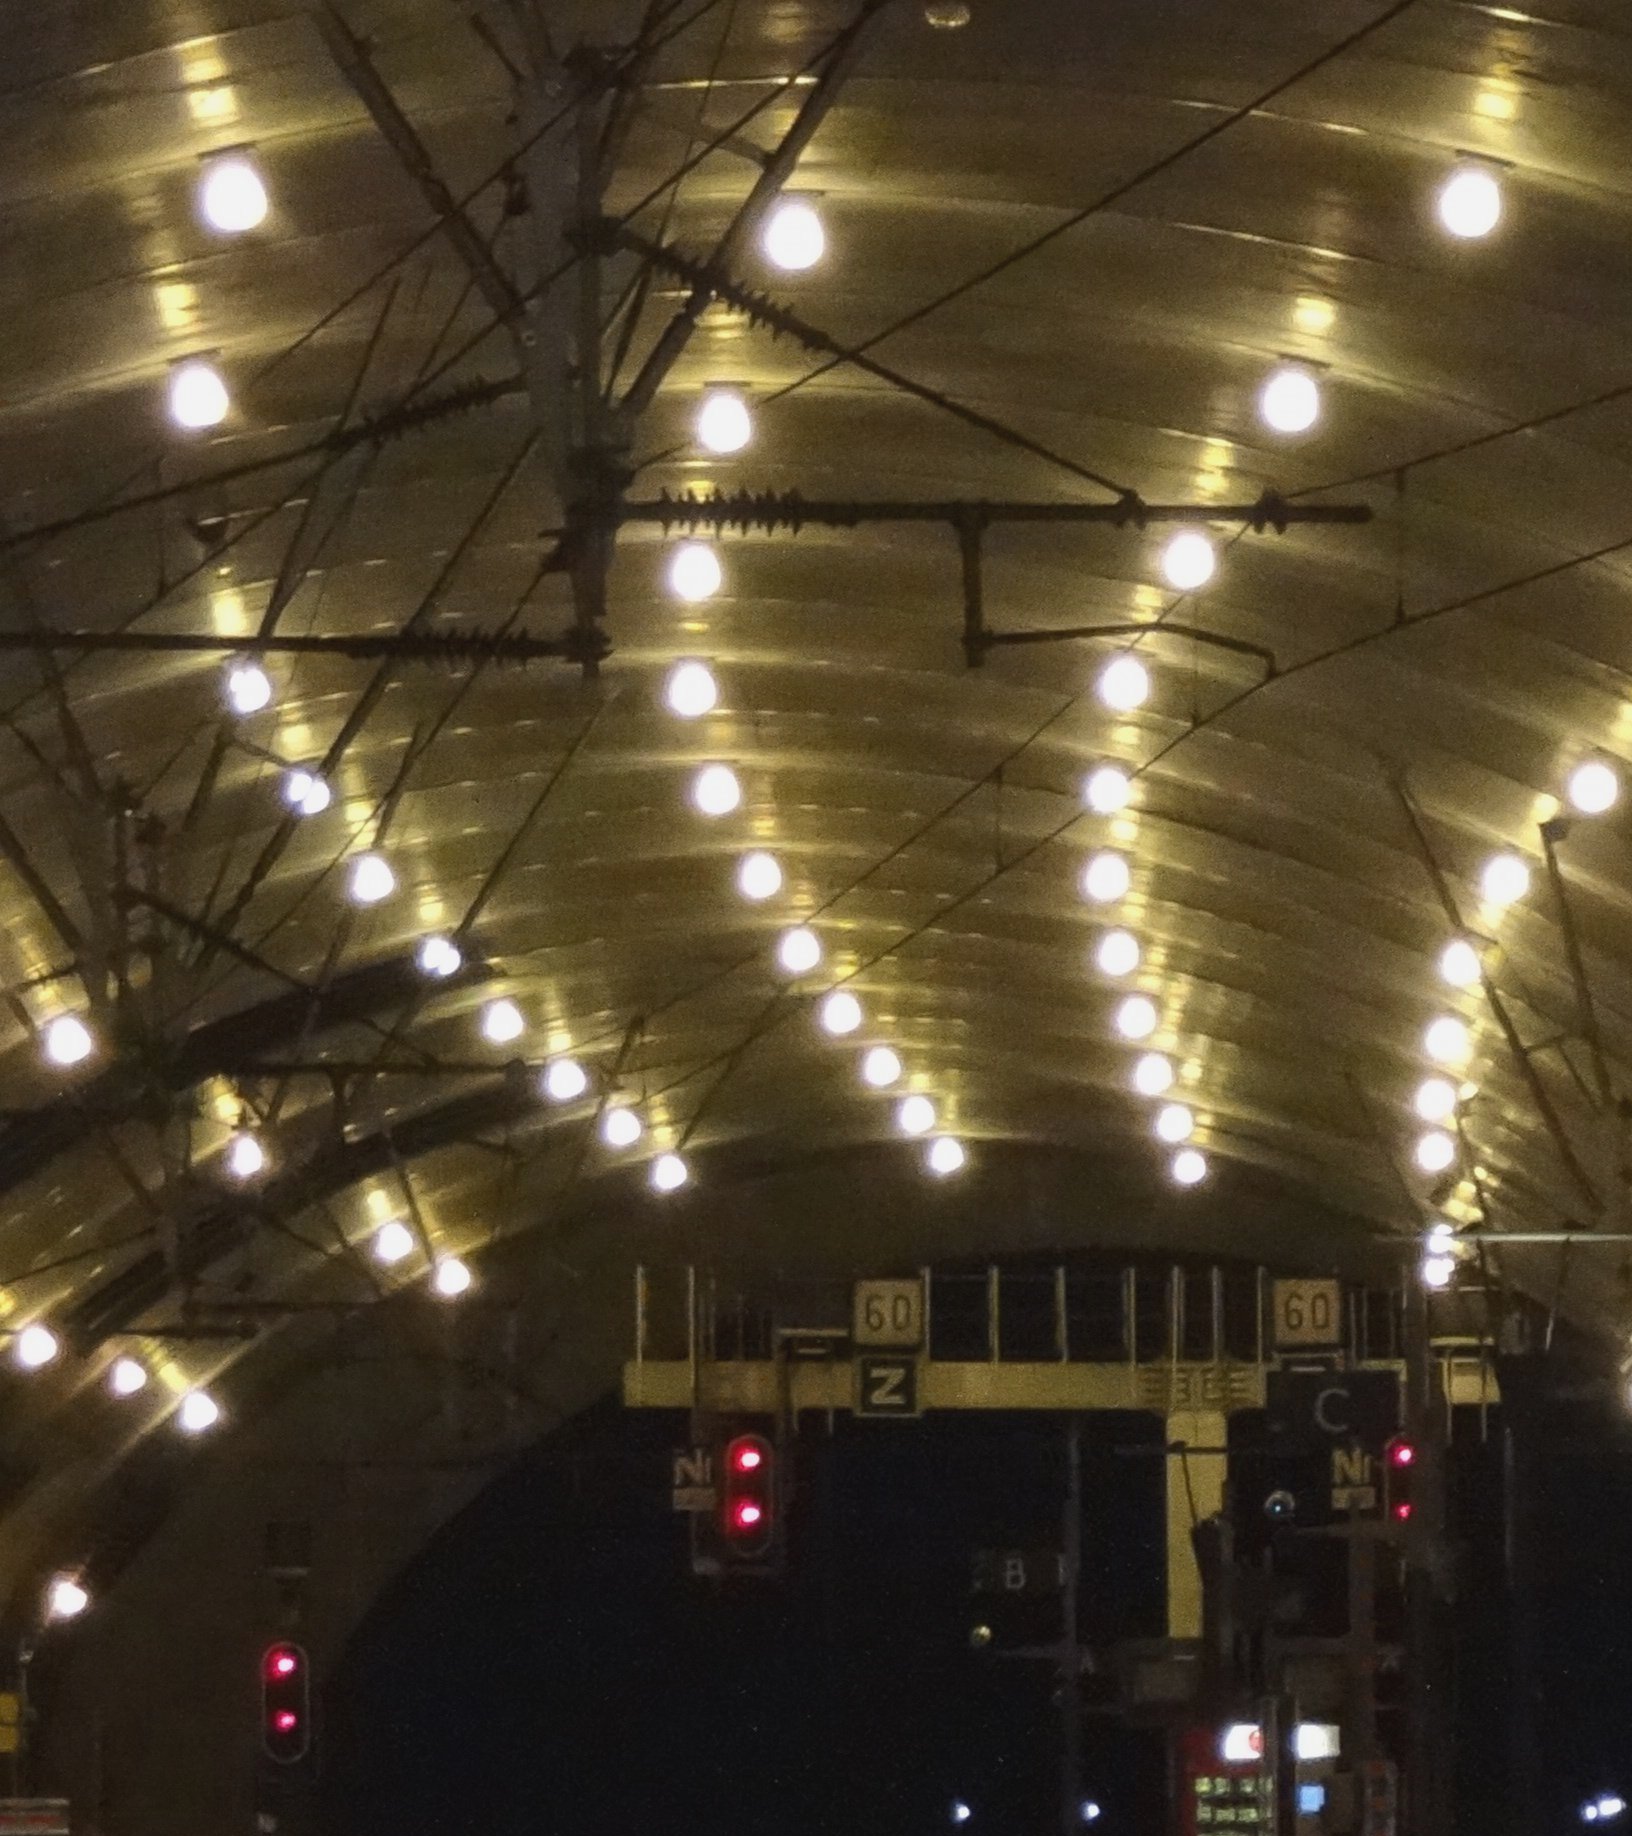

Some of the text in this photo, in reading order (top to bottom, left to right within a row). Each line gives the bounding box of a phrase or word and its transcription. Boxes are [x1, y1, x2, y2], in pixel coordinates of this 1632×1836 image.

[865, 1294, 911, 1332] 60
[1284, 1292, 1330, 1330] 60
[869, 1367, 907, 1405] Z
[1314, 1387, 1351, 1434] C
